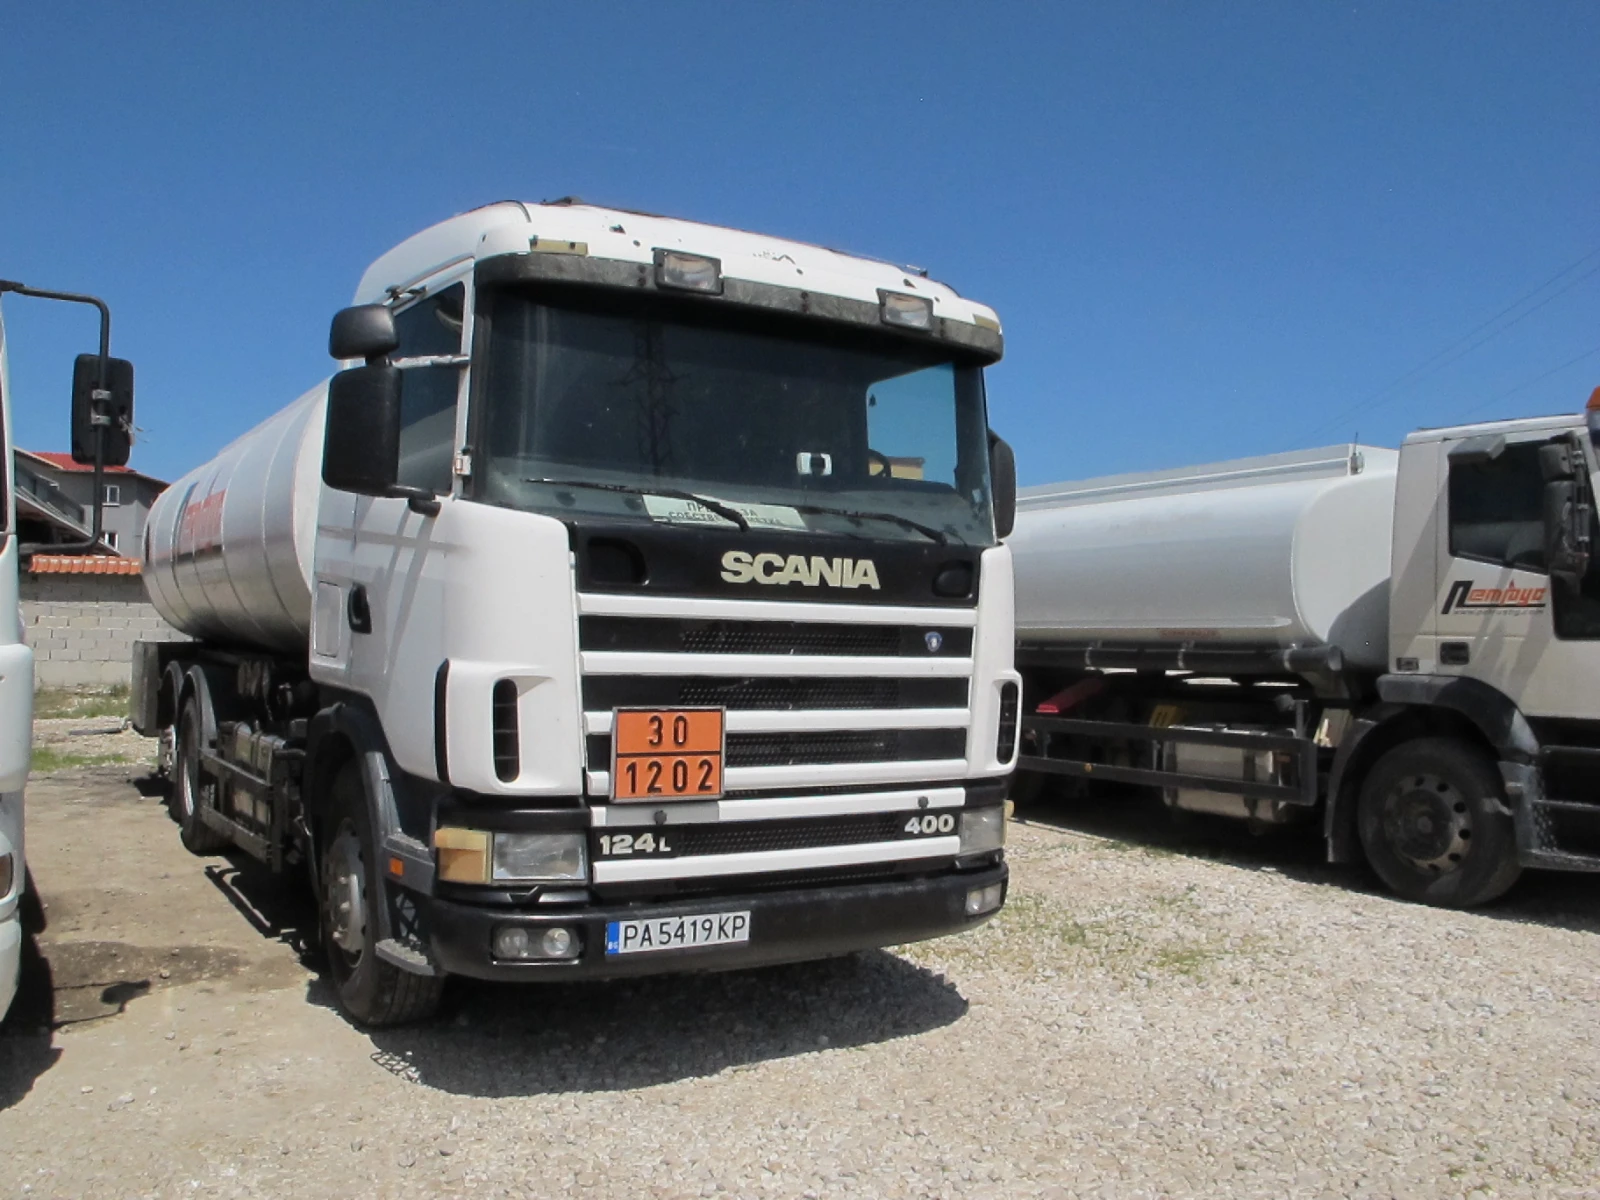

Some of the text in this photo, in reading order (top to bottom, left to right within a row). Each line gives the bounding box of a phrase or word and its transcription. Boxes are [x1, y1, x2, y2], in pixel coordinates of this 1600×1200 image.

[720, 550, 881, 590] SCANIA
[648, 715, 688, 746] 30
[626, 759, 713, 794] 1202
[904, 813, 955, 834] 400
[599, 832, 656, 855] 124
